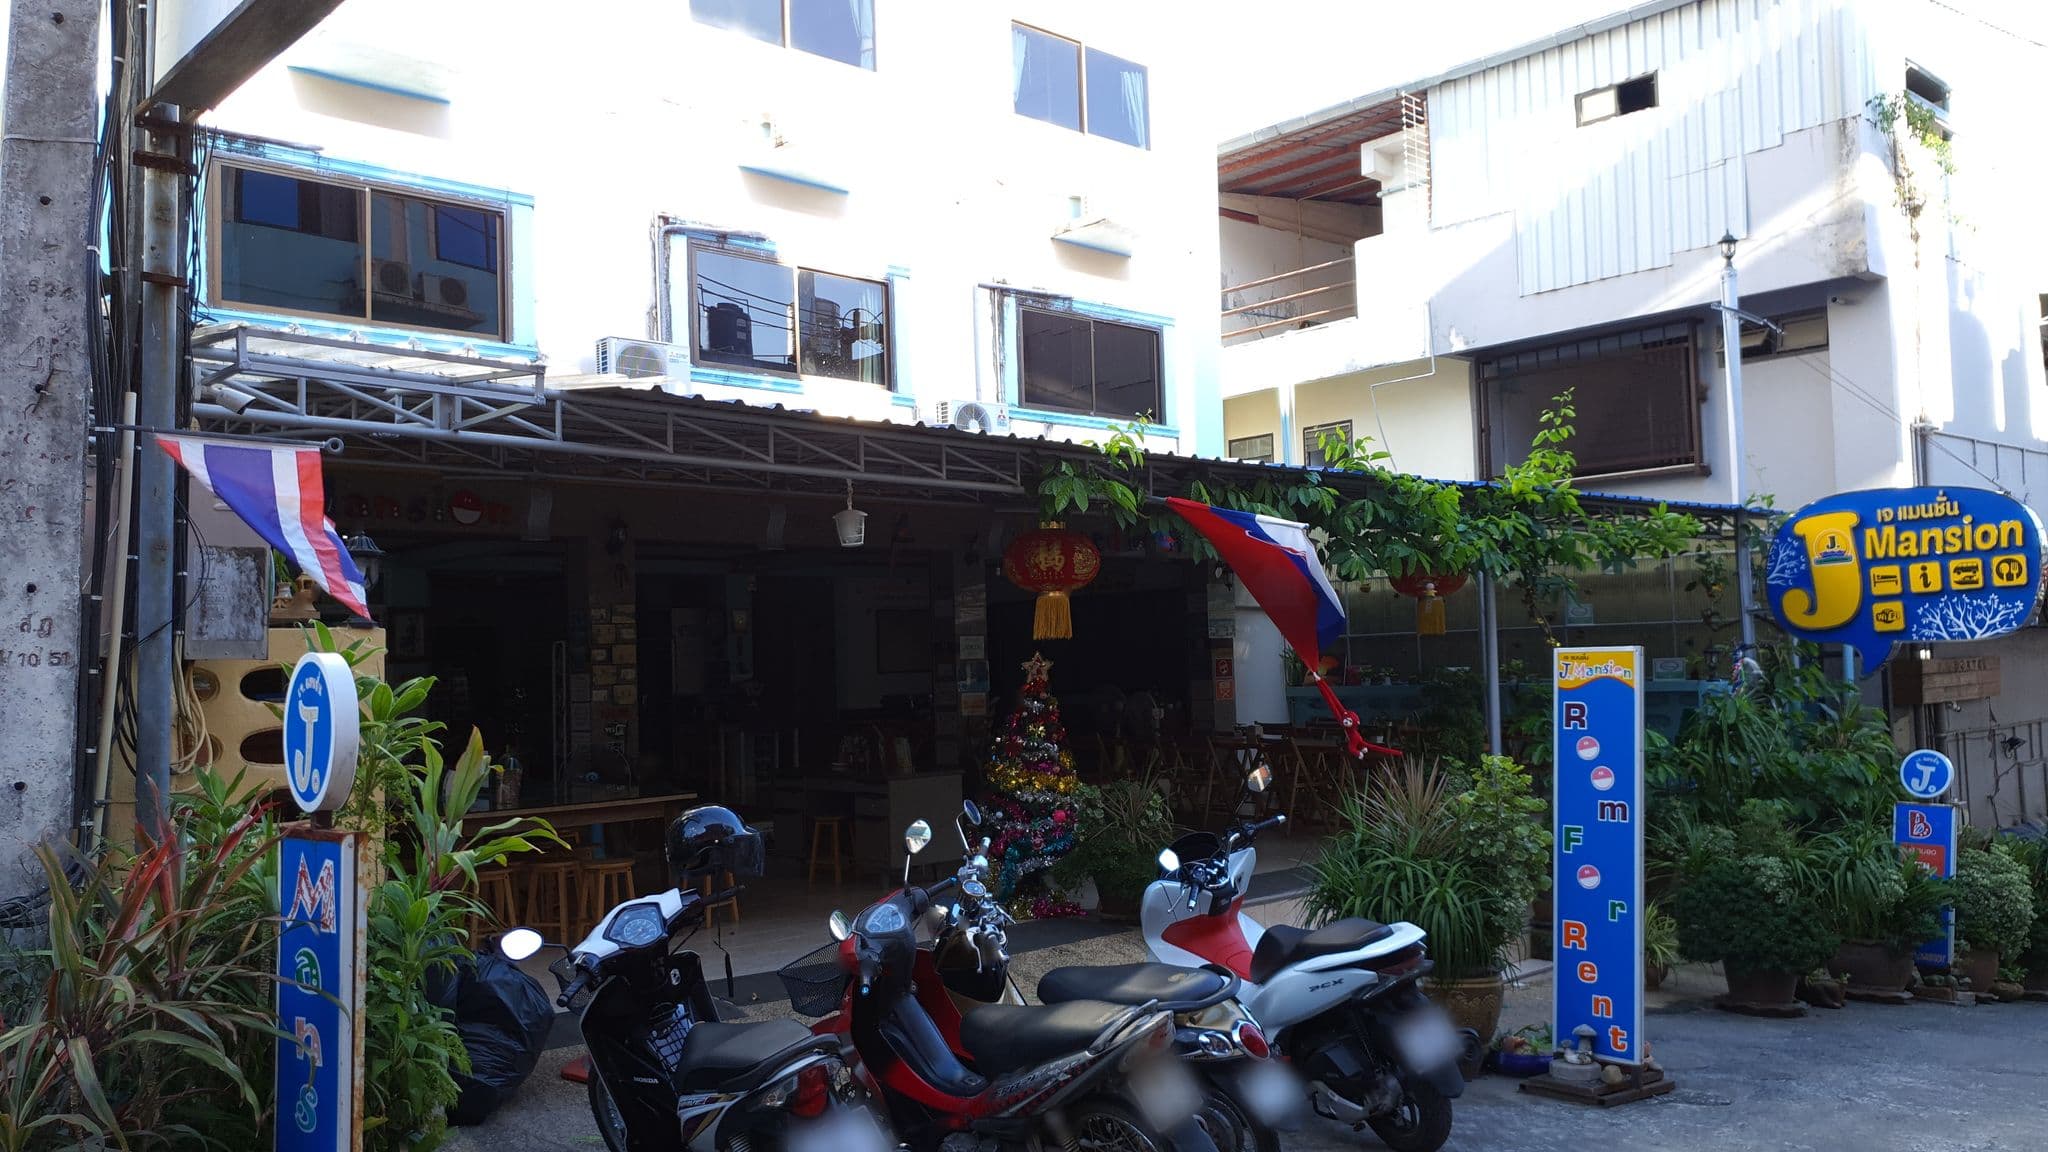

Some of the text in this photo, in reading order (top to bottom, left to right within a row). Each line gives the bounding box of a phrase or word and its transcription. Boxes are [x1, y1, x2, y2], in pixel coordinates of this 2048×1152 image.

[1876, 489, 1960, 523] เจ แมนชั่น
[1863, 514, 2024, 560] Mansion
[1562, 919, 1628, 1052] Rent
